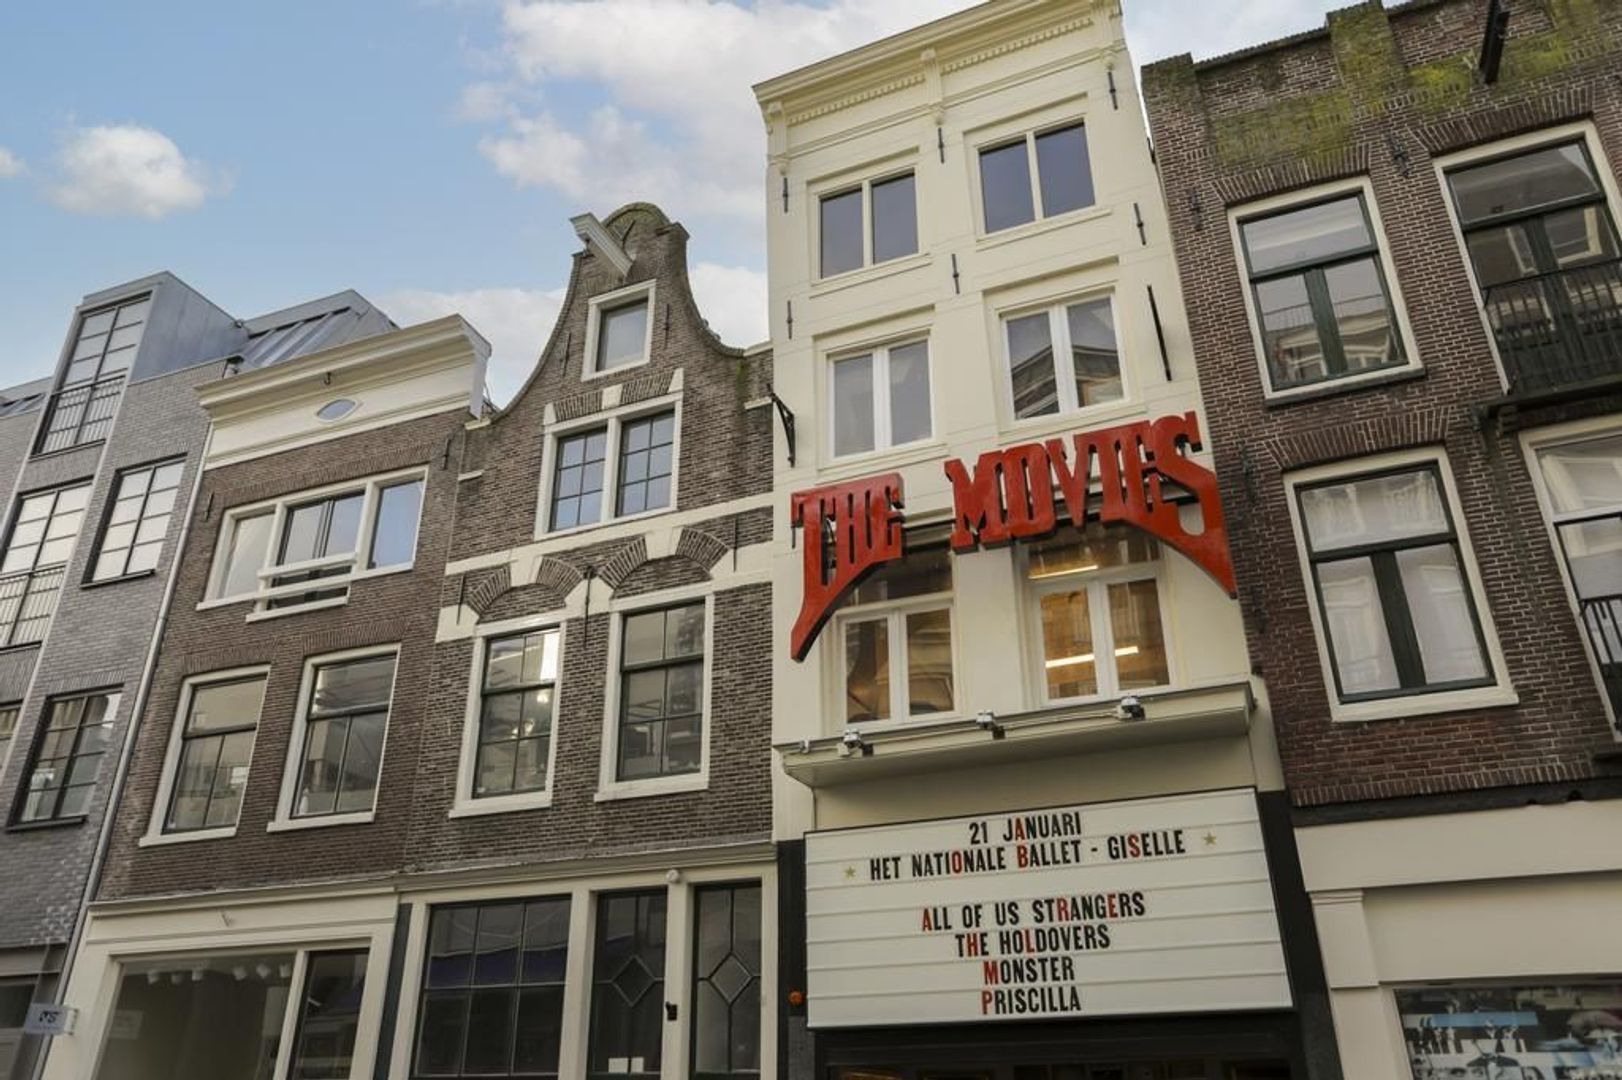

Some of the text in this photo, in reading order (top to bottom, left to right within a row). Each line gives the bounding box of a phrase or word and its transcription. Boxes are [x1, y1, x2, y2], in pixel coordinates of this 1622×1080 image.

[791, 411, 1237, 661] THE MOVIES
[969, 812, 1082, 845] 21 JANUARI
[869, 855, 900, 880] HET
[911, 847, 1006, 876] NATIONALE
[1017, 840, 1082, 868] BALLET
[1108, 830, 1186, 859] GISELLE
[921, 892, 1145, 932] ALL OF US STRANGERS
[955, 924, 1111, 957] THE HOLDOVERS
[983, 957, 1075, 986] MONSTER
[981, 986, 1081, 1015] PRISCILLA
